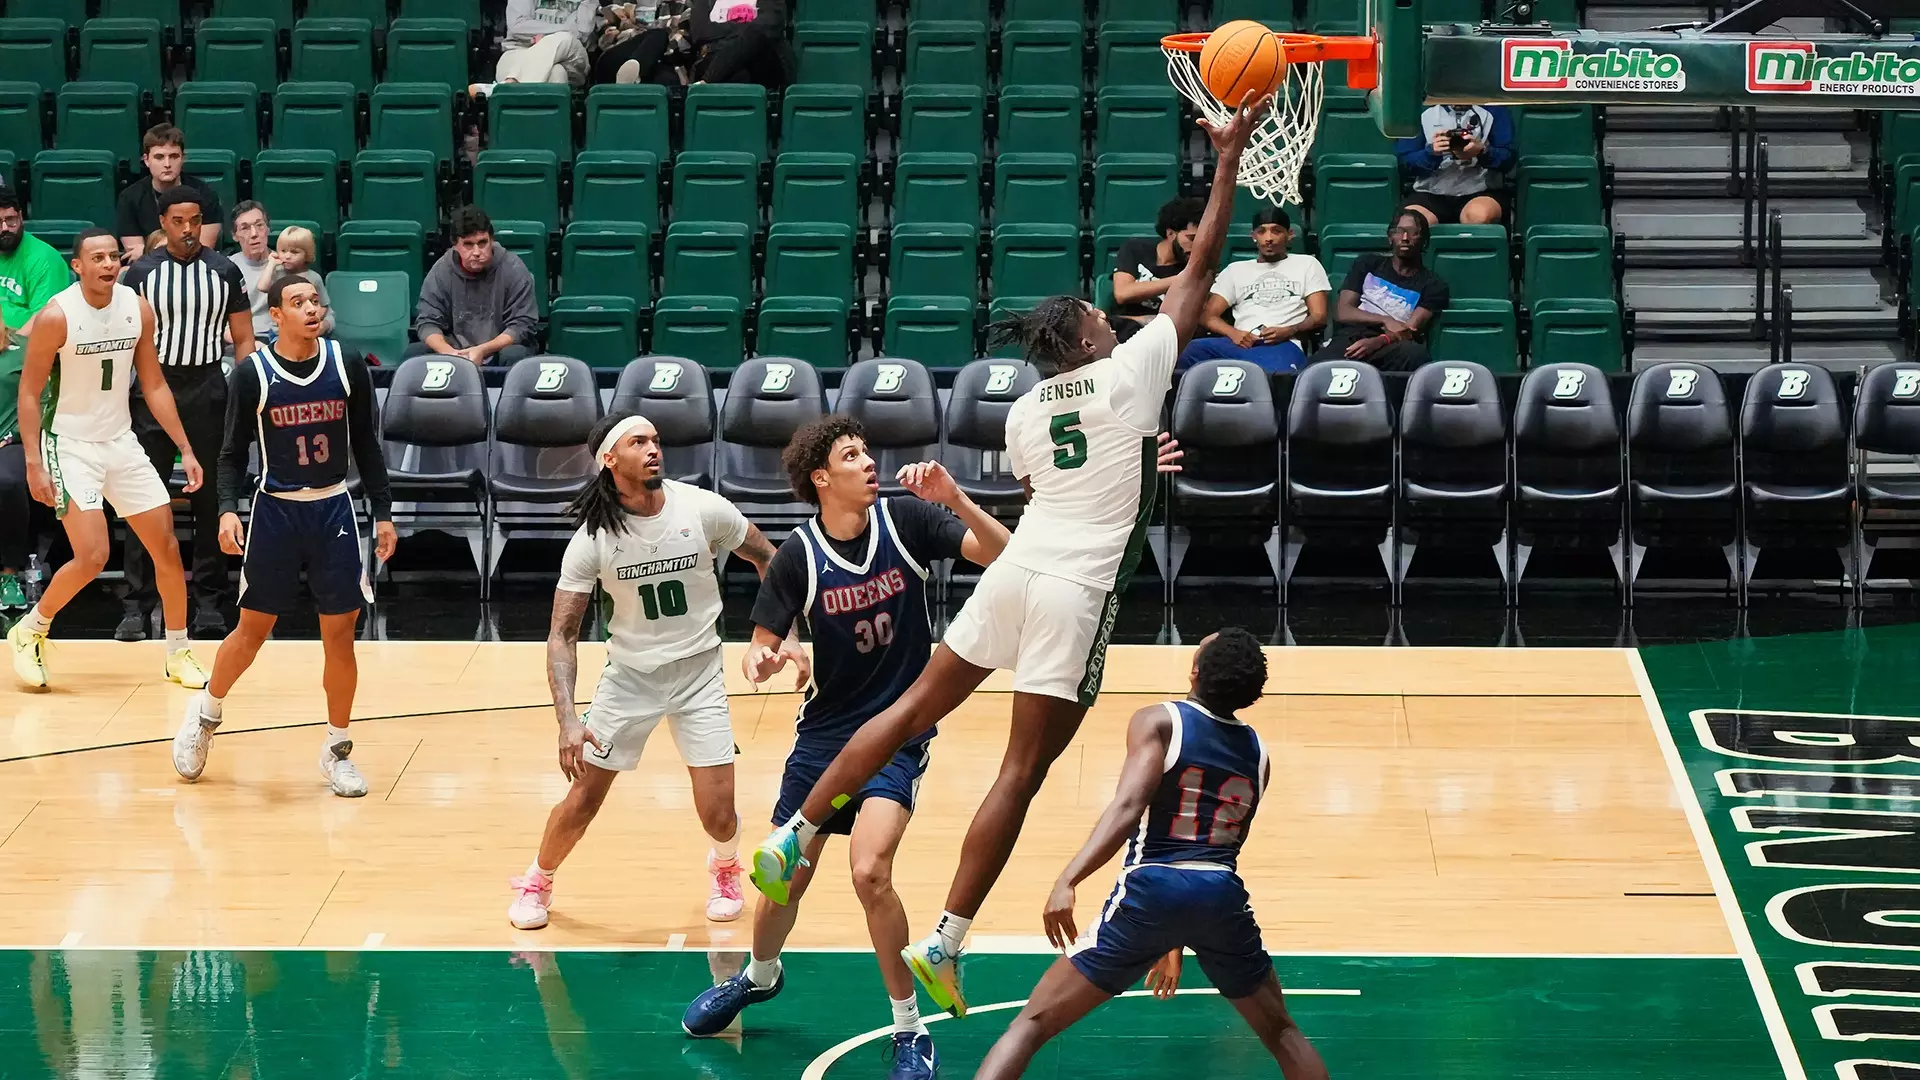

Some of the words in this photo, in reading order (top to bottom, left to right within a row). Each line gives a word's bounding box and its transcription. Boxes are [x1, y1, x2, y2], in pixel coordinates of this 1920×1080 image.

[1575, 79, 1640, 90] CONVENIENCE
[1643, 79, 1679, 90] STORES
[1819, 83, 1859, 93] ENERGY
[1862, 84, 1915, 94] PRODUCTS
[101, 358, 113, 390] 1
[421, 361, 456, 391] B
[534, 362, 569, 392] B
[650, 362, 685, 393] B
[760, 363, 795, 394] B
[872, 364, 907, 394] B
[985, 364, 1020, 395] B
[1211, 365, 1246, 396] B
[1326, 367, 1361, 397] B
[1439, 367, 1474, 397] B
[1552, 368, 1586, 399] B
[1666, 368, 1700, 398] B
[1777, 369, 1811, 399] B
[1892, 369, 1920, 399] B
[1039, 378, 1095, 403] BENSON
[270, 400, 346, 427] QUEENS
[296, 433, 330, 466] 13
[1048, 410, 1088, 470] 5
[616, 553, 698, 580] BINGHAMTON
[637, 580, 688, 620] 10
[822, 567, 907, 616] QUEENS
[854, 611, 894, 655] 30
[1168, 764, 1255, 848] 12
